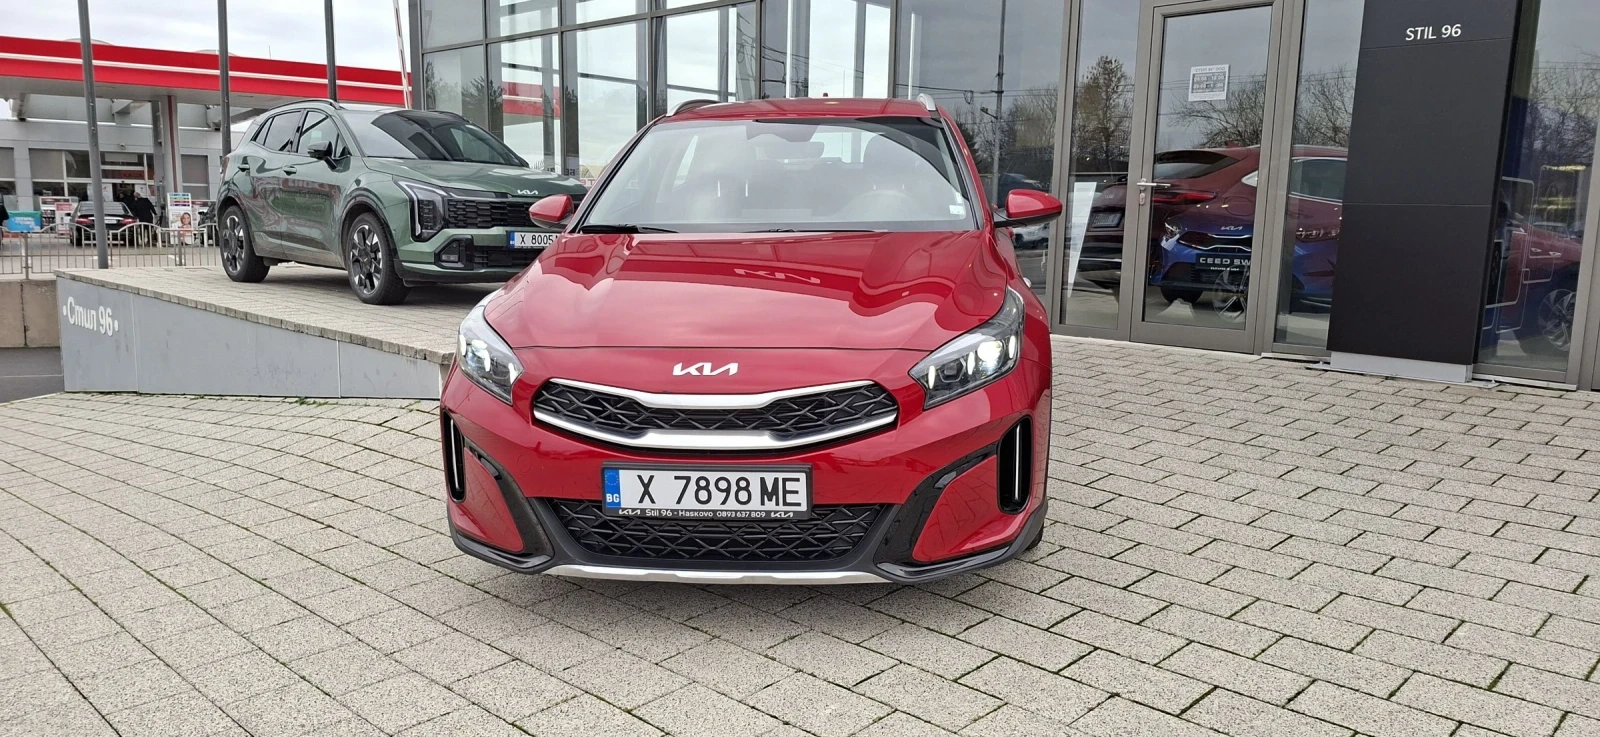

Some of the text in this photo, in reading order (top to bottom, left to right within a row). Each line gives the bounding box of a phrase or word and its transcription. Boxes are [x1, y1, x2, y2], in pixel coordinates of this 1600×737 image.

[1405, 23, 1462, 41] STIL 96
[520, 234, 526, 244] X
[672, 362, 739, 376] KIA
[636, 474, 802, 507] X 7898 ME
[606, 493, 620, 503] BG
[618, 508, 641, 516] KIA
[645, 508, 659, 517] Stil
[660, 509, 672, 517] 96
[679, 509, 714, 518] Haskovo
[716, 510, 736, 518] 0893
[736, 510, 750, 518] 637
